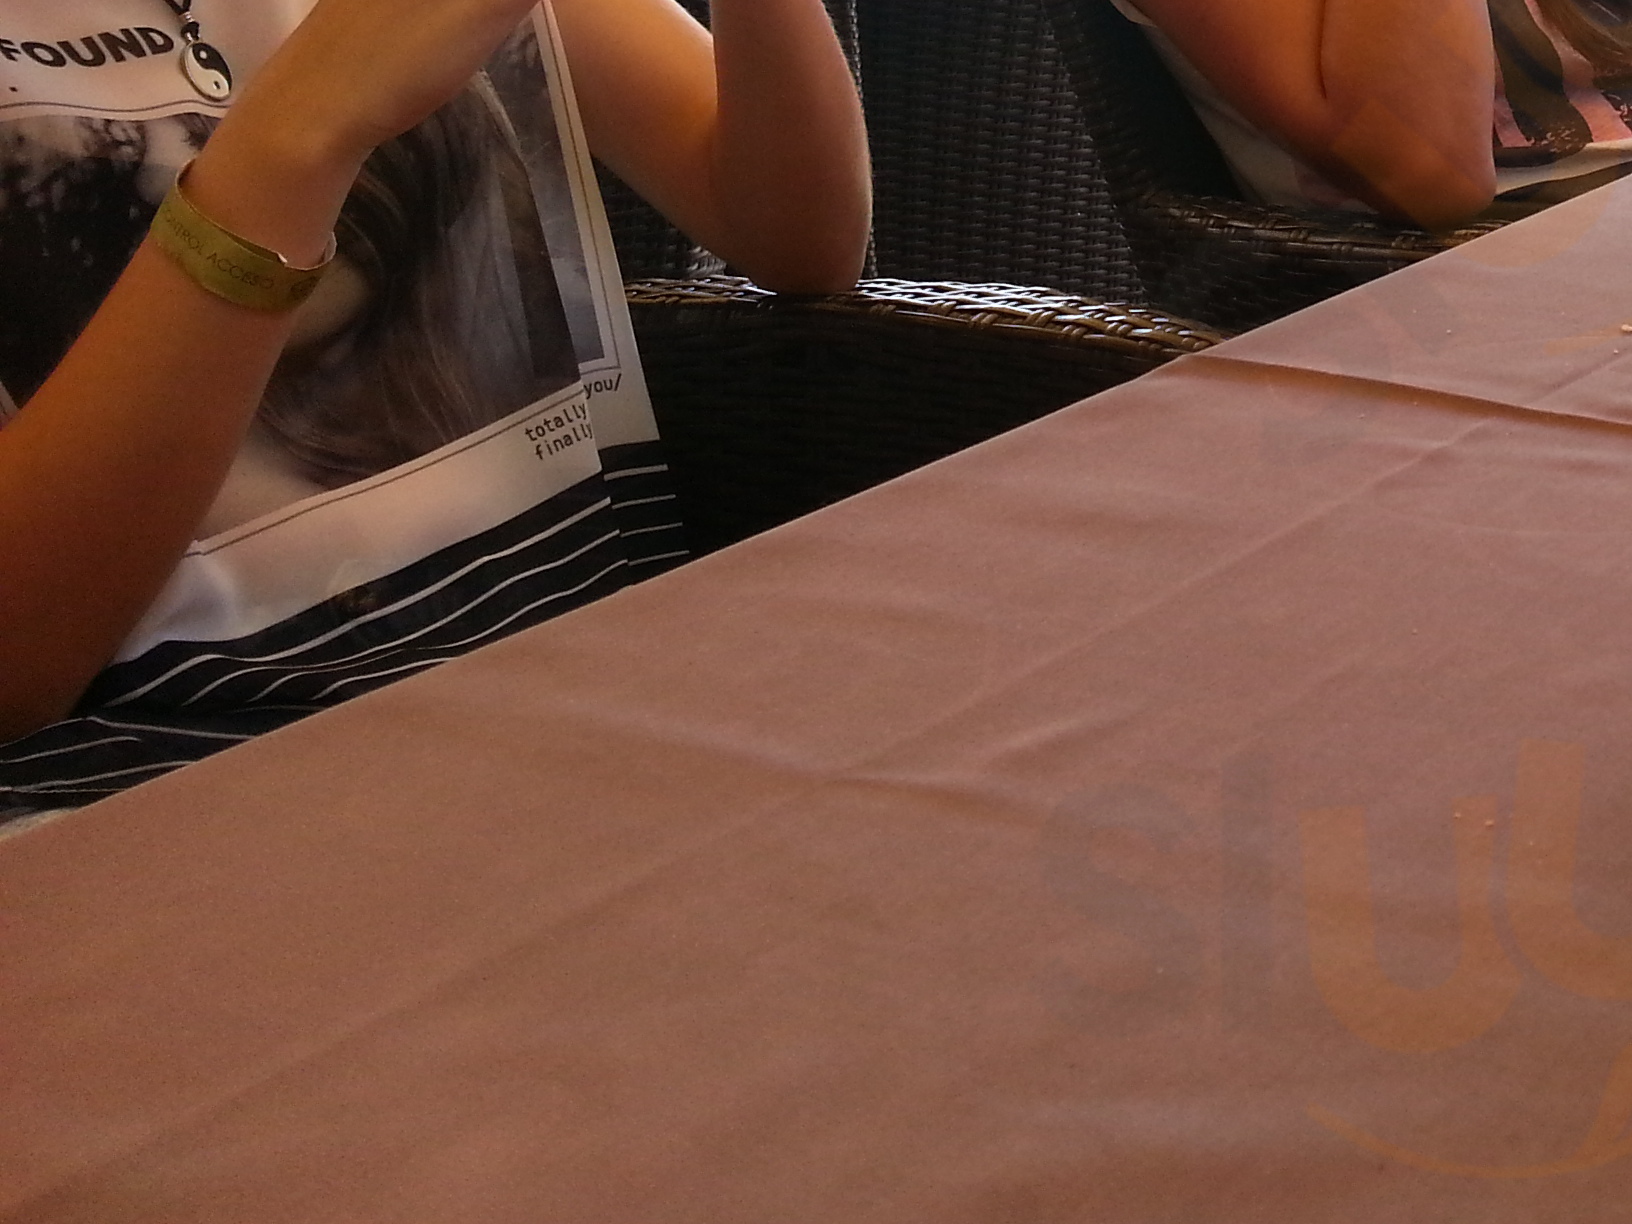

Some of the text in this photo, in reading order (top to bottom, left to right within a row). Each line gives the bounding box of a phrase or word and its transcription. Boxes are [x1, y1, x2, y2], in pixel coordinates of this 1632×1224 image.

[0, 26, 175, 68] FOUND
[206, 252, 275, 289] ACCESO
[583, 373, 622, 399] you/
[525, 403, 588, 442] totally
[535, 423, 594, 460] finally
